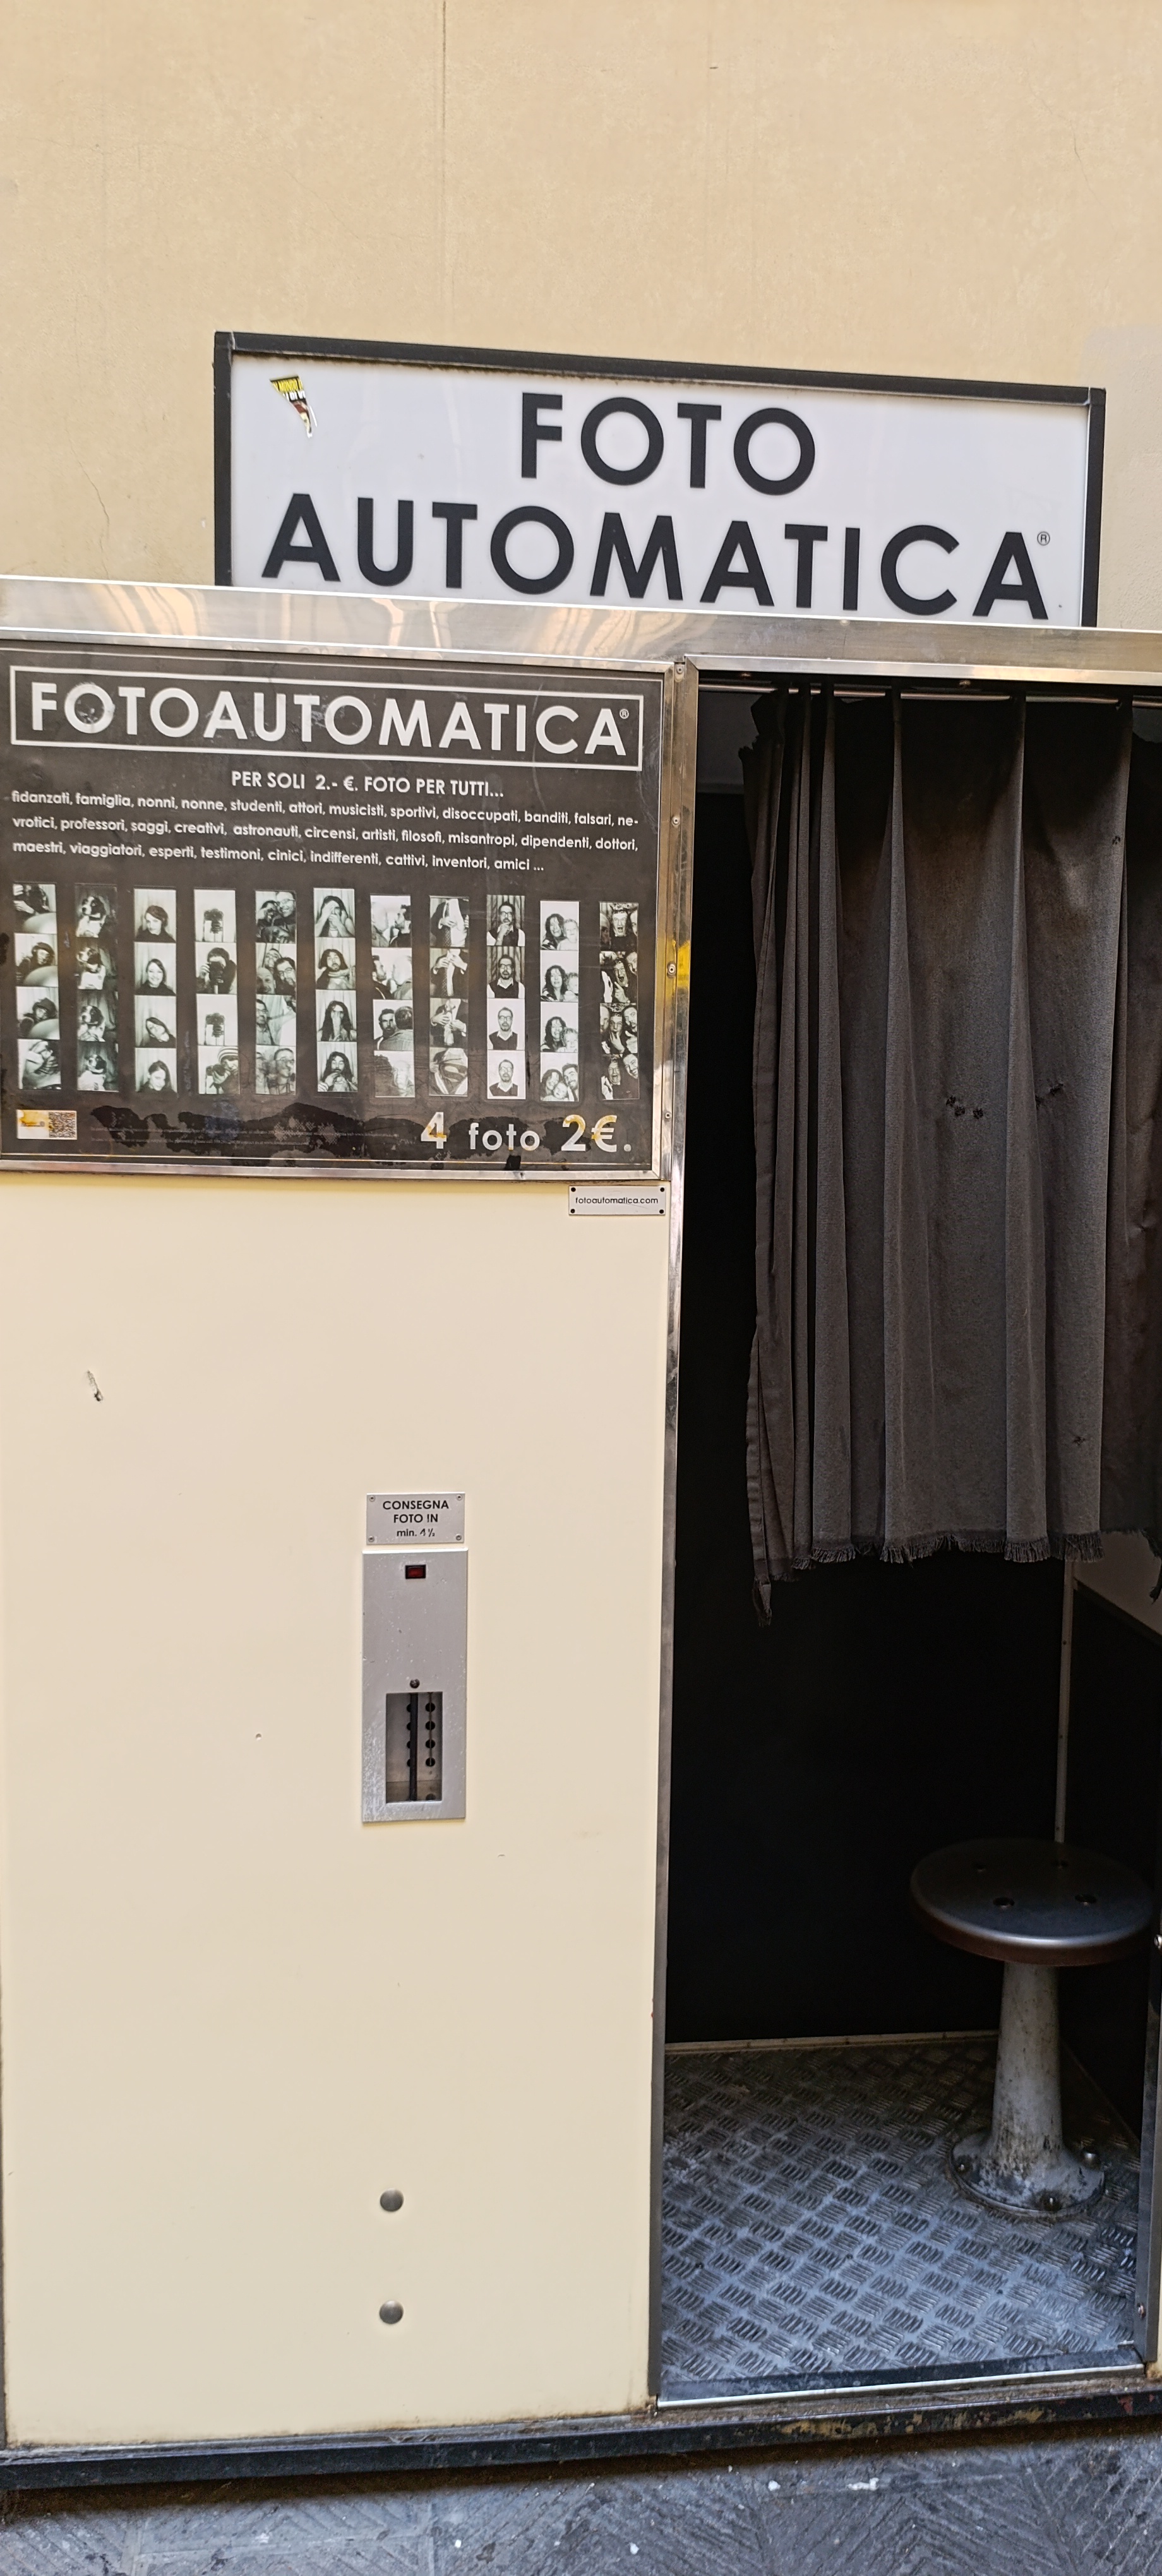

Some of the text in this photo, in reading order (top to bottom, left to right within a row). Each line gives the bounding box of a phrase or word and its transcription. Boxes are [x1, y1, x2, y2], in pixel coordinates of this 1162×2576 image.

[520, 391, 816, 496] FOTO
[232, 771, 262, 787] PER
[267, 772, 305, 789] SOLI
[364, 776, 410, 793] FOTO
[416, 778, 445, 795] PER
[450, 780, 504, 797] TUTTI...
[11, 790, 638, 827] fidanzati, famiglia, nonni, nonne, studenti, attori, musicisti, sportivi, disoccupati, banditi, falsari, ne-
[12, 816, 638, 852] vrotici, professori, saggi, creativi, astronauti, circensi, artisti, filosofi, misantropi, dipendenti, dottori,
[13, 841, 66, 855] maestri,
[69, 842, 145, 857] viaggiatori,
[148, 846, 197, 860] esperti,
[200, 846, 264, 862] testimoni,
[267, 849, 307, 863] cinici,
[310, 850, 381, 866] indifferenti,
[385, 854, 428, 868] cattivi,
[432, 855, 490, 870] inventori,
[494, 858, 530, 870] amici
[421, 1111, 447, 1149] 4
[469, 1122, 540, 1152] foto
[575, 1196, 659, 1205] fotoautomatica.com
[383, 1500, 449, 1510] CONSEGNA
[393, 1513, 438, 1524] FOTO IN
[397, 1529, 417, 1537] min.
